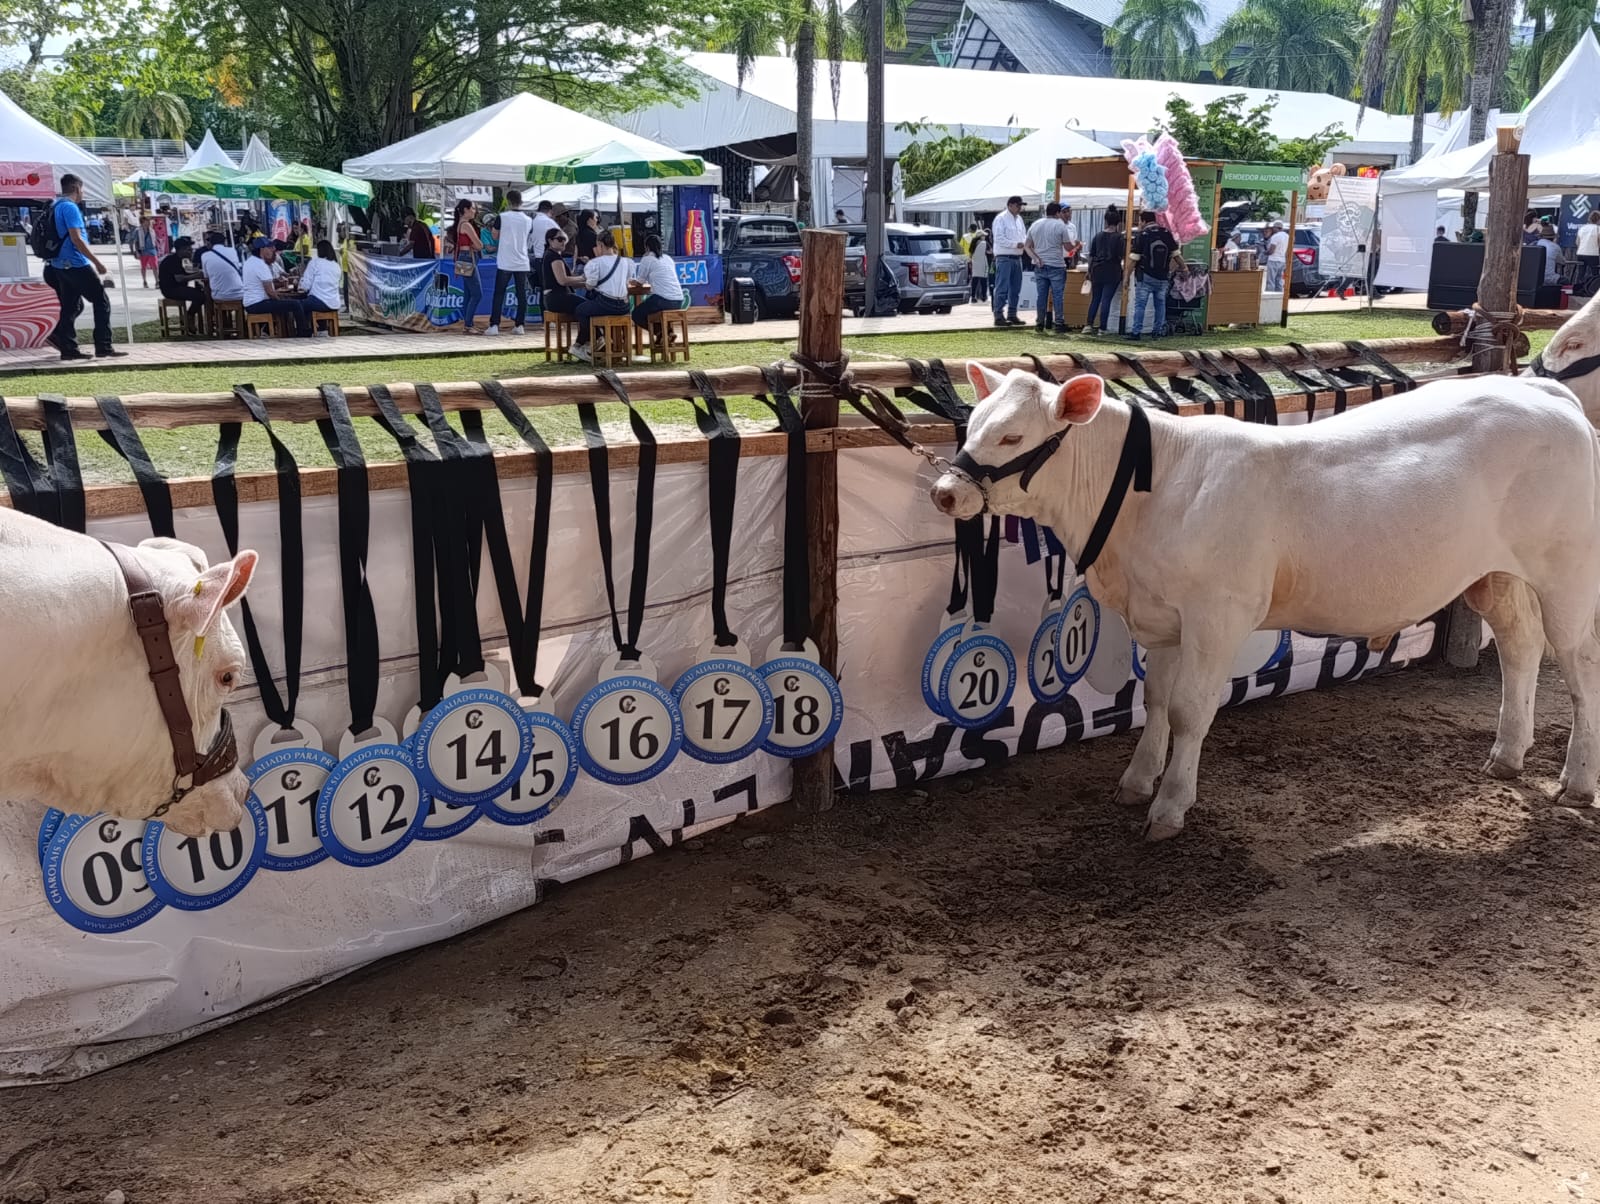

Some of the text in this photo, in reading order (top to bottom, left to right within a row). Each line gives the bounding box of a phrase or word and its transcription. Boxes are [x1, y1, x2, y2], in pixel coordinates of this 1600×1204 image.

[1224, 173, 1300, 183] VENDEDOR AUTORIZADO
[1066, 617, 1087, 666] 01
[587, 694, 599, 703] SU
[599, 680, 630, 697] ALIADO
[631, 679, 653, 691] PARA
[653, 686, 681, 724] PRODUCIR
[695, 662, 725, 676] ALIADO
[726, 663, 747, 675] PARA
[746, 671, 772, 707] PRODUCIR
[766, 661, 795, 673] ALIADO
[796, 662, 816, 674] PARA
[815, 670, 841, 704] PRODUCIR
[958, 668, 1000, 710] 20
[415, 720, 435, 769] CHAROLAIS
[431, 709, 444, 720] SU
[443, 693, 477, 711] ALIADO
[478, 692, 499, 703] PARA
[500, 698, 529, 734] PRODUCIR
[531, 715, 550, 725] PARA
[550, 720, 577, 754] PRODUCIR
[600, 716, 659, 760] 16
[695, 698, 751, 740] 17
[774, 695, 820, 736] 18
[256, 752, 292, 773] ALIADO
[294, 752, 318, 762] PARA
[446, 729, 507, 781] 14
[318, 786, 334, 838] CHAROLAIS
[330, 773, 342, 785] SU
[342, 750, 371, 773] ALIADO
[374, 748, 395, 757] PARA
[348, 784, 408, 841] 12
[263, 790, 319, 845] 11
[47, 845, 63, 904] CHAROLAIS
[59, 830, 71, 845] SU
[145, 825, 160, 882] CHAROLAIS
[177, 827, 243, 883] 10
